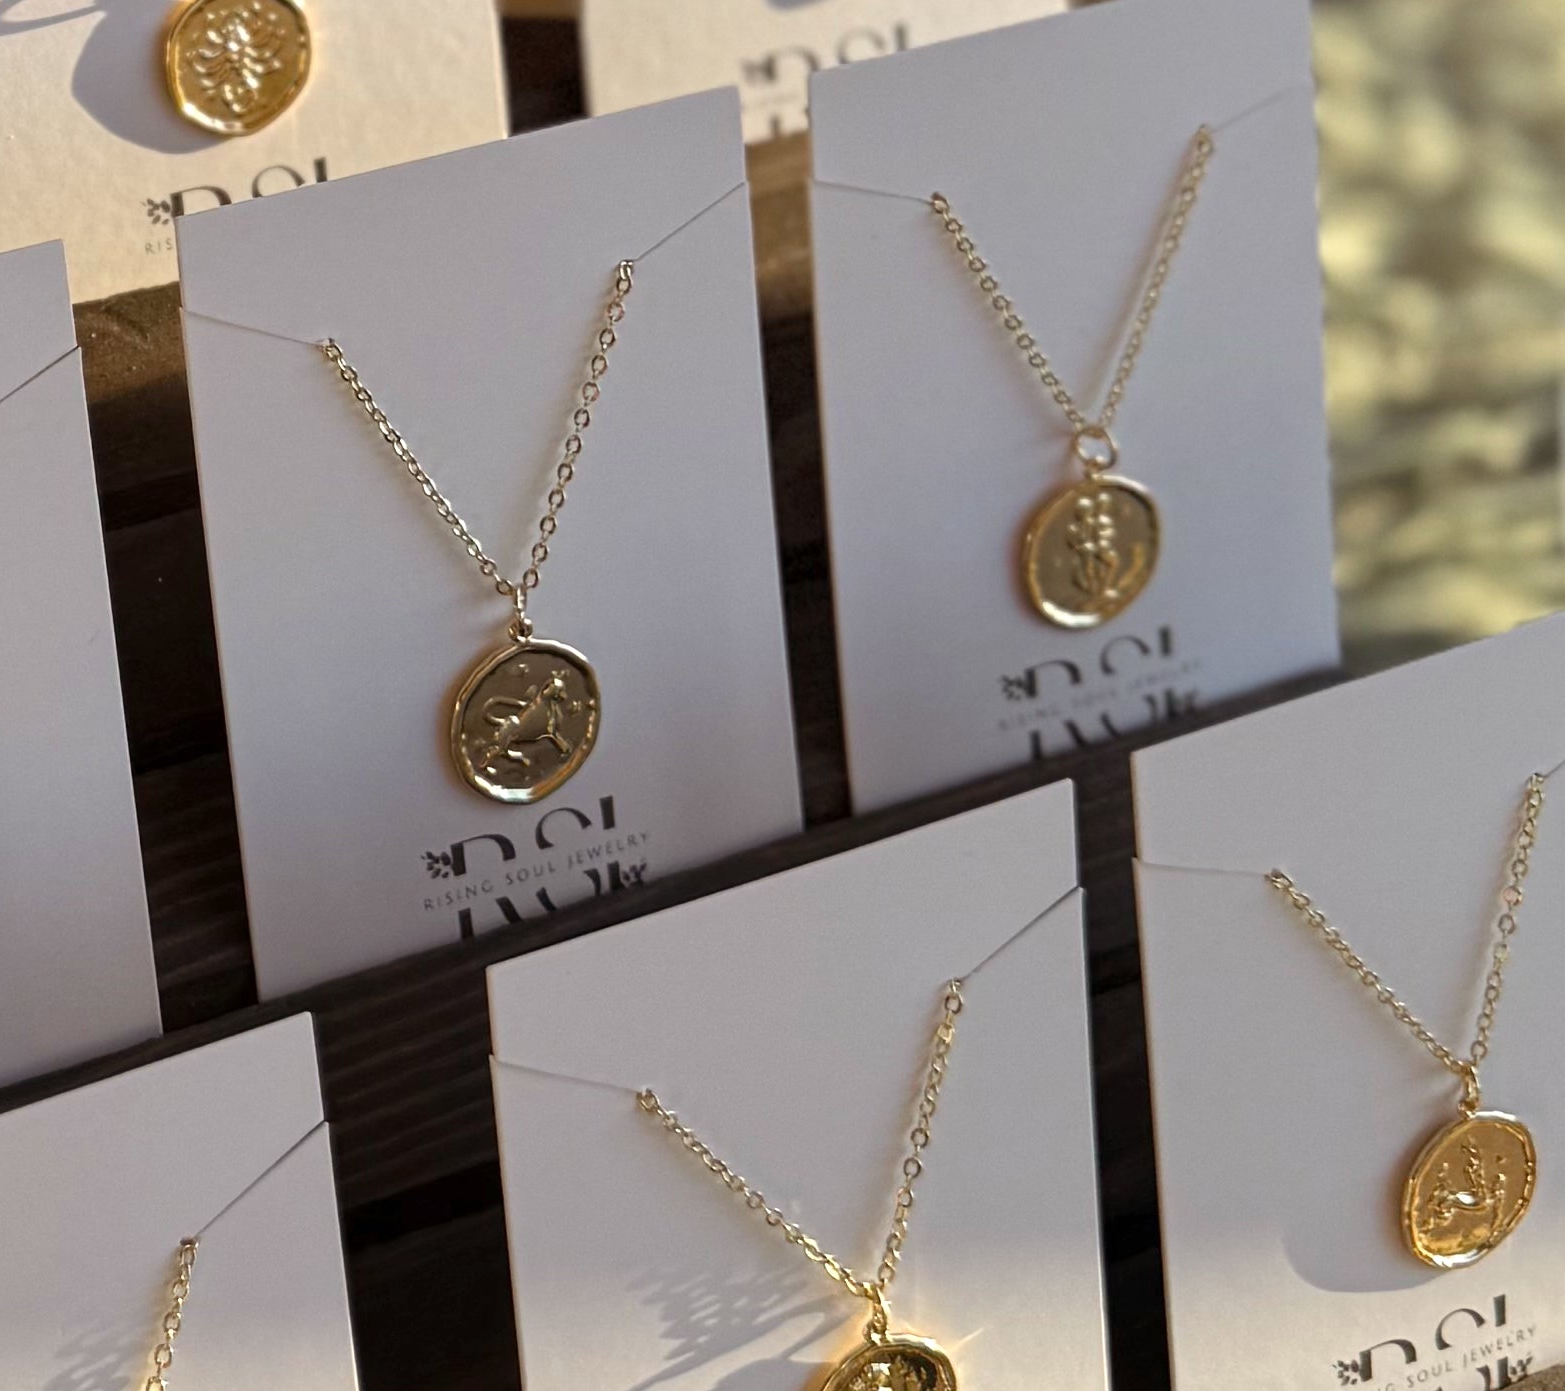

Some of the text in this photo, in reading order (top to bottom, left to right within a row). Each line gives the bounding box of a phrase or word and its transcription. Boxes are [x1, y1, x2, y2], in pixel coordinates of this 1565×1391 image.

[424, 832, 650, 910] RISING SOUL JEWELRY
[1406, 1360, 1456, 1389] SOUL
[1463, 1325, 1538, 1369] JEWELRY
